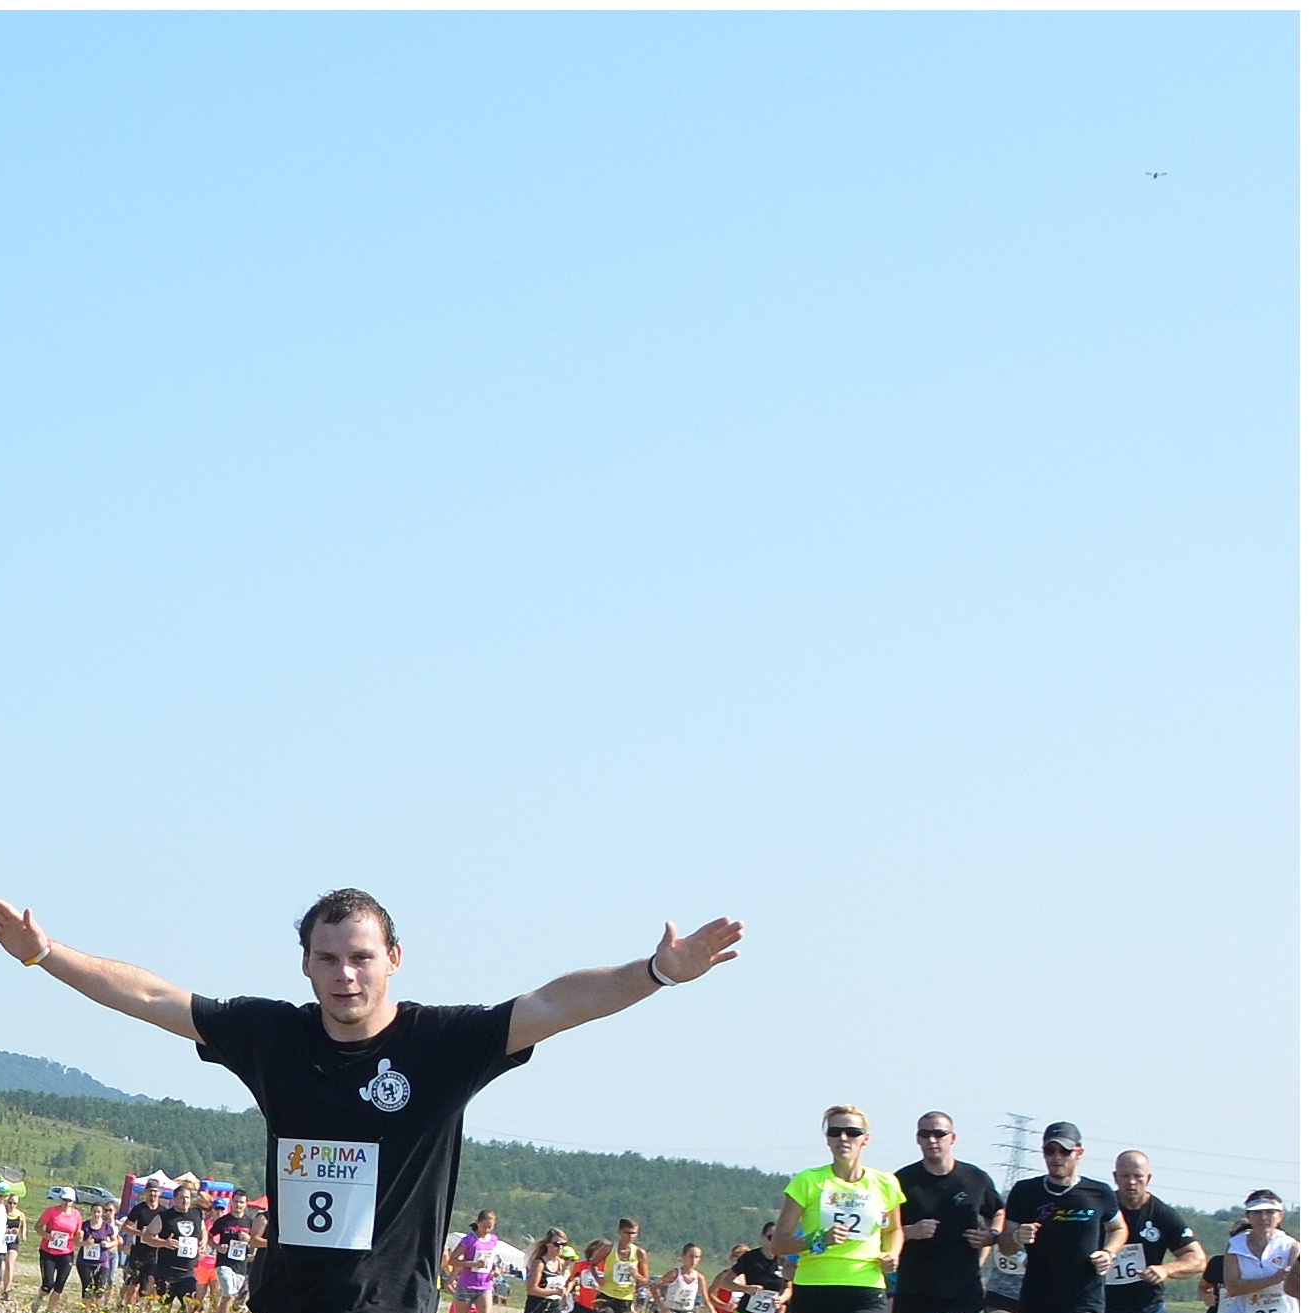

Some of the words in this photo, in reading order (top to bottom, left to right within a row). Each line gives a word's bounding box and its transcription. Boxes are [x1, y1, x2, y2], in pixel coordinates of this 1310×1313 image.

[310, 1145, 367, 1163] PRIMA
[317, 1161, 358, 1179] BĚHY
[307, 1191, 333, 1233] 8
[834, 1212, 861, 1233] 52
[1113, 1261, 1137, 1280] 16
[753, 1300, 771, 1312] 29
